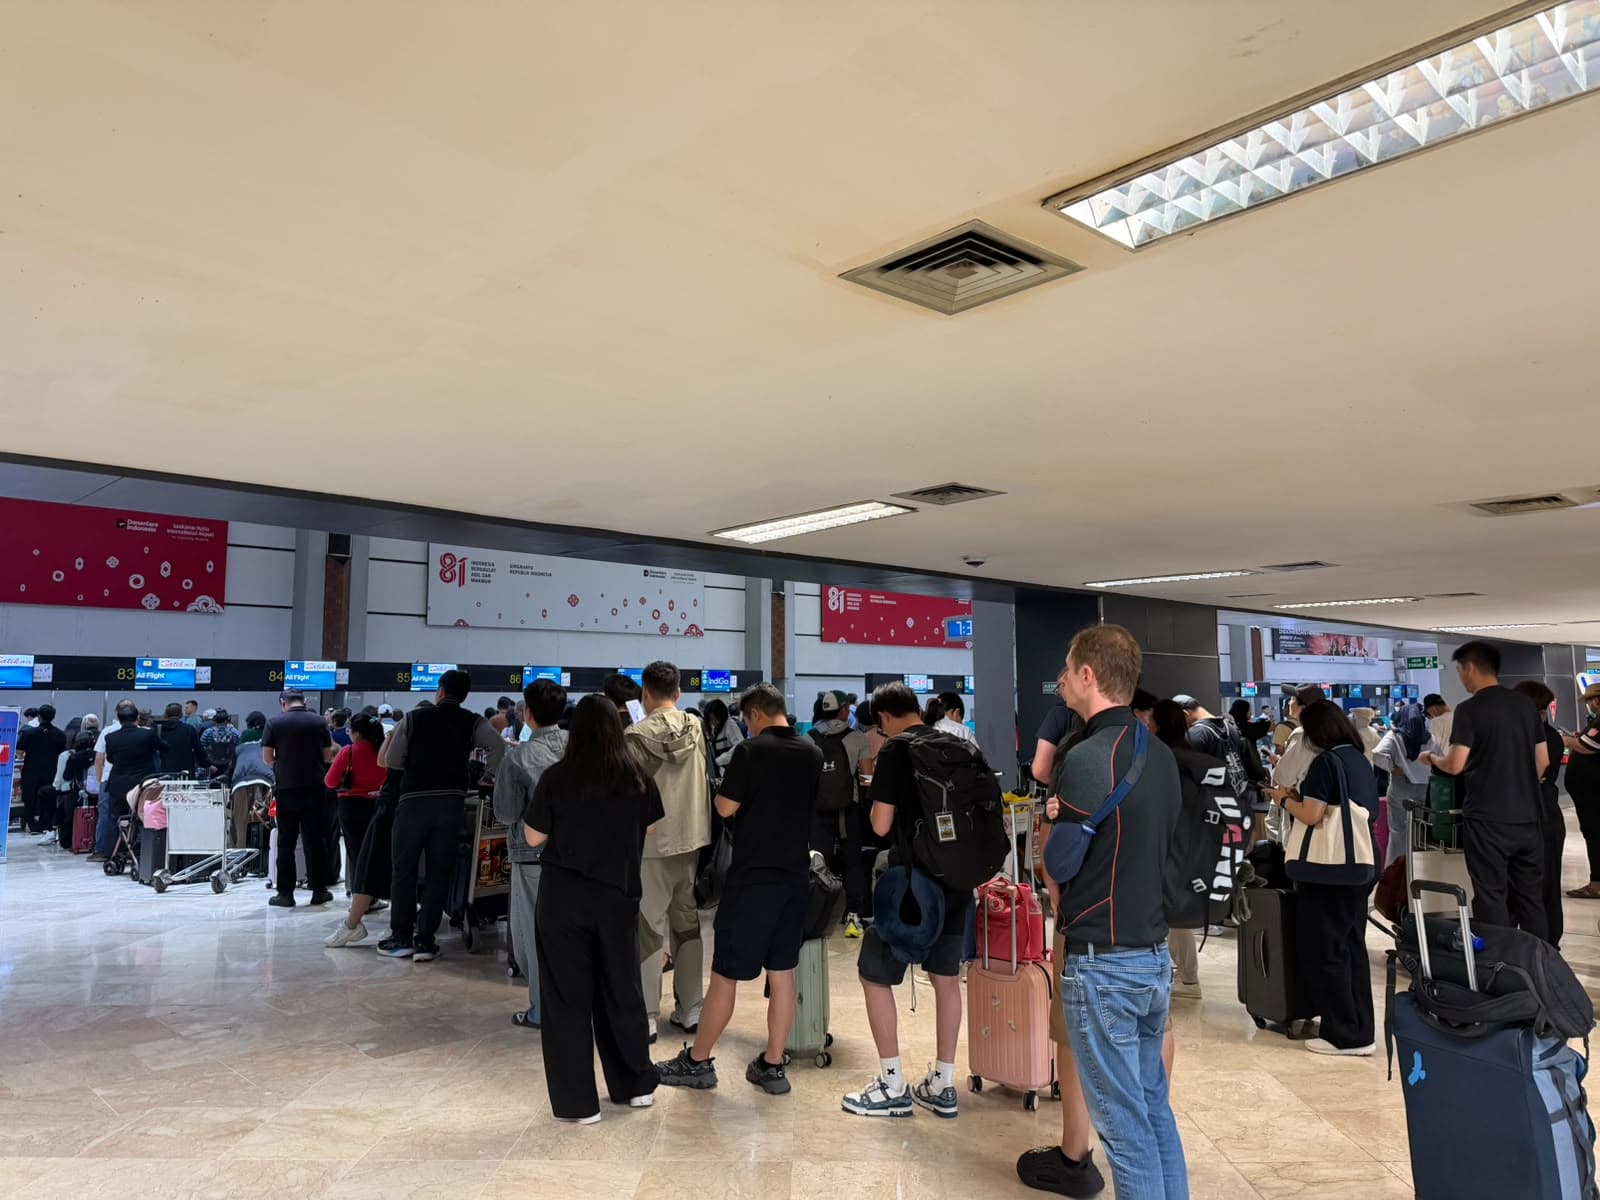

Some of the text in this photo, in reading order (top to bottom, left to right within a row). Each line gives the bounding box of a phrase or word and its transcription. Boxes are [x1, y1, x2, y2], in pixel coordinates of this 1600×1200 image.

[439, 552, 469, 588] 81
[828, 586, 846, 614] 81
[955, 620, 973, 636] 7:3
[116, 667, 135, 680] 83
[146, 672, 165, 680] Flight
[268, 670, 284, 682] 84
[397, 672, 411, 683] 85
[509, 674, 521, 684] 86
[708, 677, 729, 685] IndiGo
